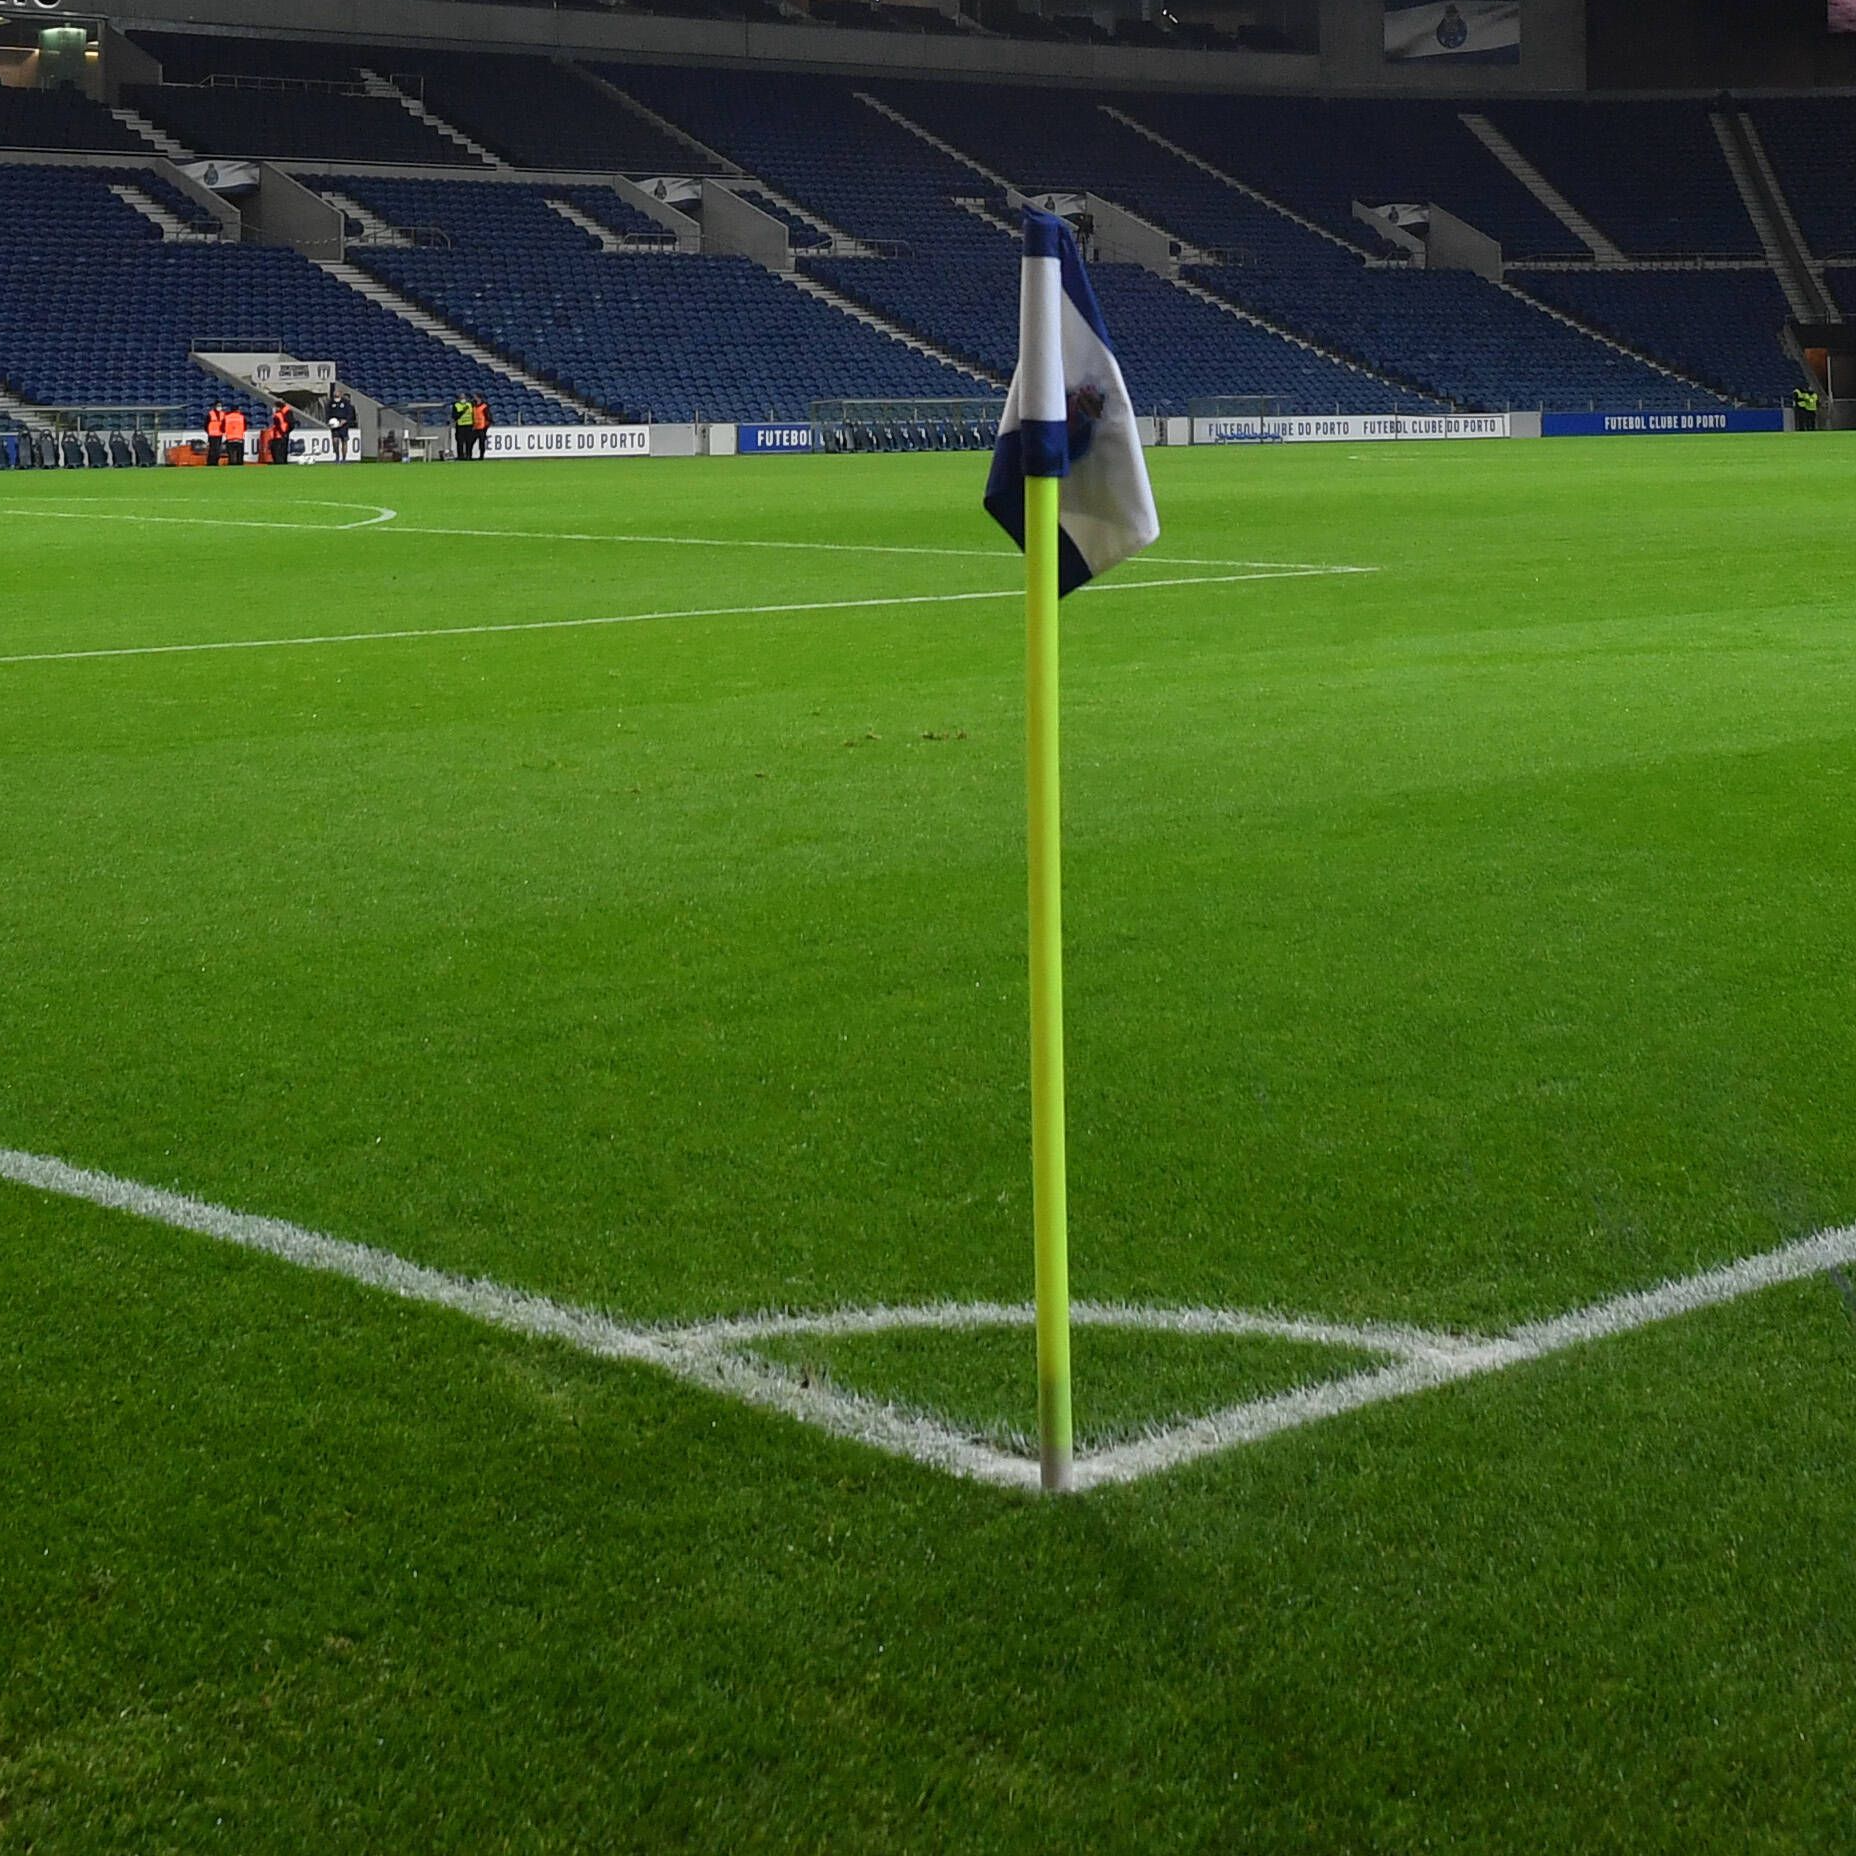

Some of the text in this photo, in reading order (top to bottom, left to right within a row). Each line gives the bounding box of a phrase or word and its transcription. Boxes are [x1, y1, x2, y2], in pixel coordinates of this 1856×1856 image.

[1298, 422, 1312, 436] DO
[1316, 421, 1350, 436] PORTO
[1363, 420, 1408, 434] FUTEBOL
[1412, 420, 1443, 434] CLUBE
[1447, 420, 1460, 433] DO
[1463, 419, 1496, 433] PORTO
[1603, 414, 1727, 431] FUTEBOL CLUBE DO PORTO
[311, 437, 361, 454] POO
[486, 432, 645, 451] EBOL CLUBE DO PORTO
